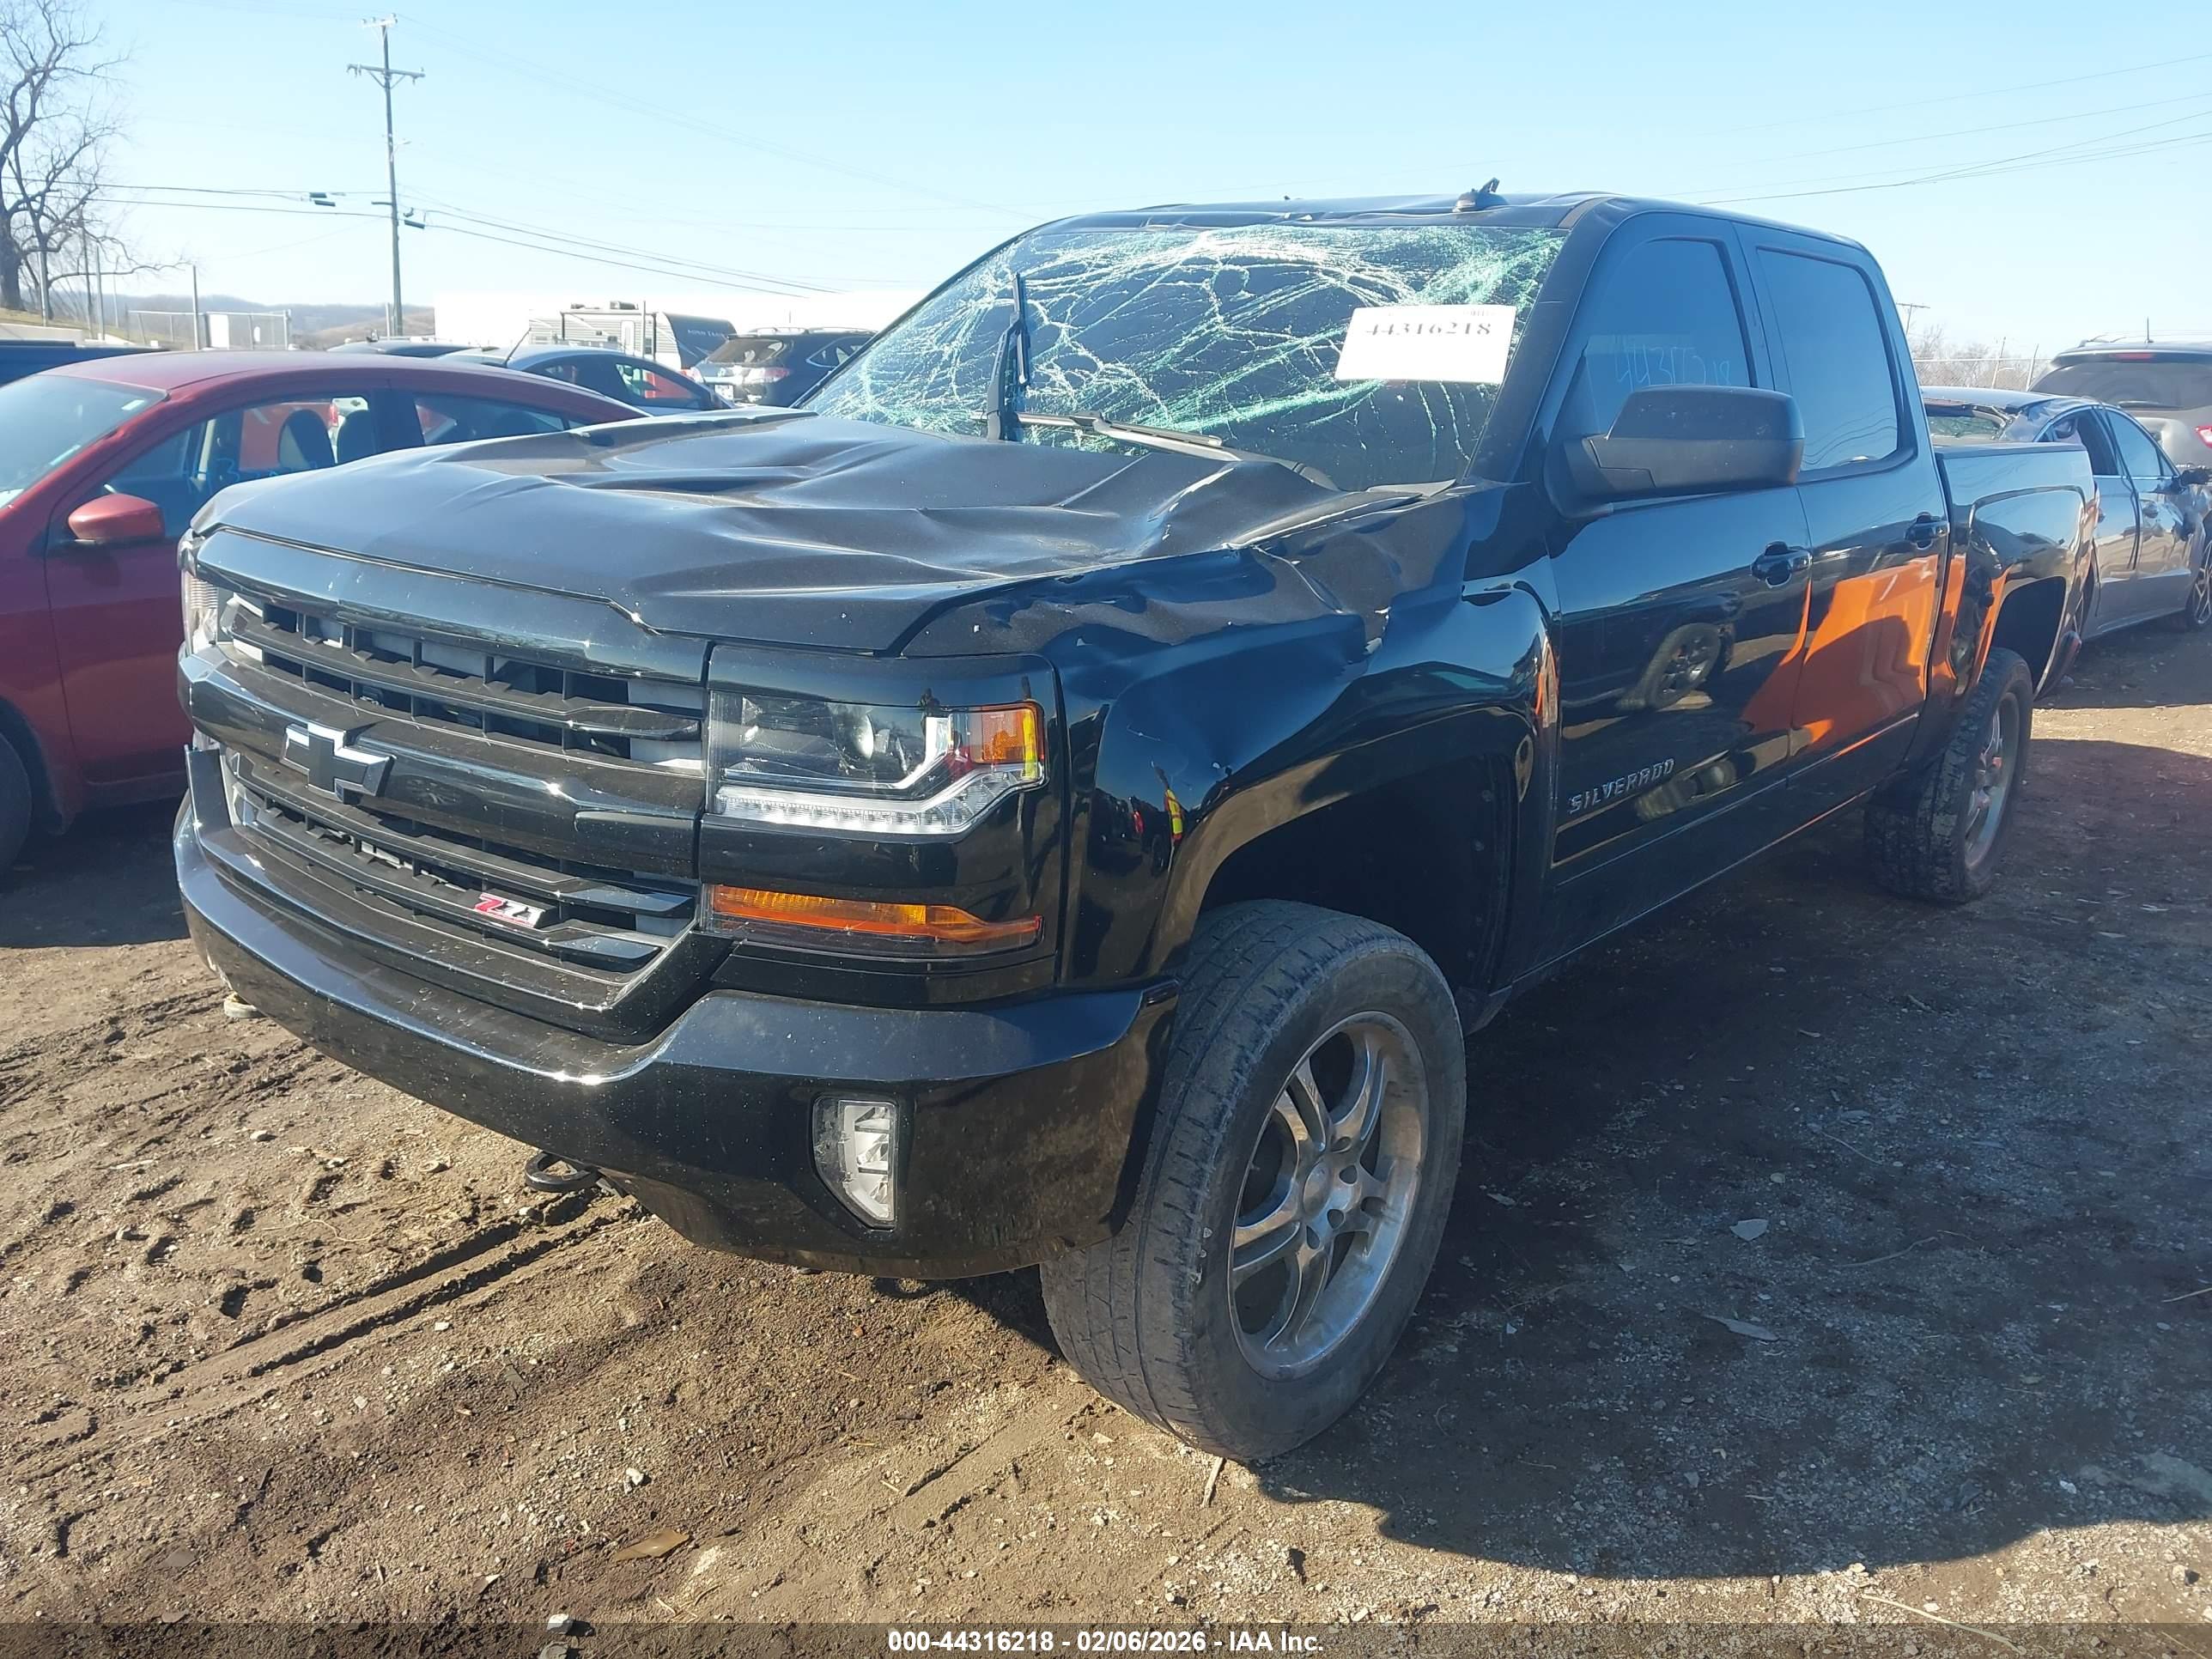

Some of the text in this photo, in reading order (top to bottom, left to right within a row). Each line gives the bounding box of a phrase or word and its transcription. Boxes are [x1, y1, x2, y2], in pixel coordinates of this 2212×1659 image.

[1365, 321, 1492, 336] 44316218
[1567, 757, 1675, 814] SILVERADO
[474, 892, 547, 928] Z71
